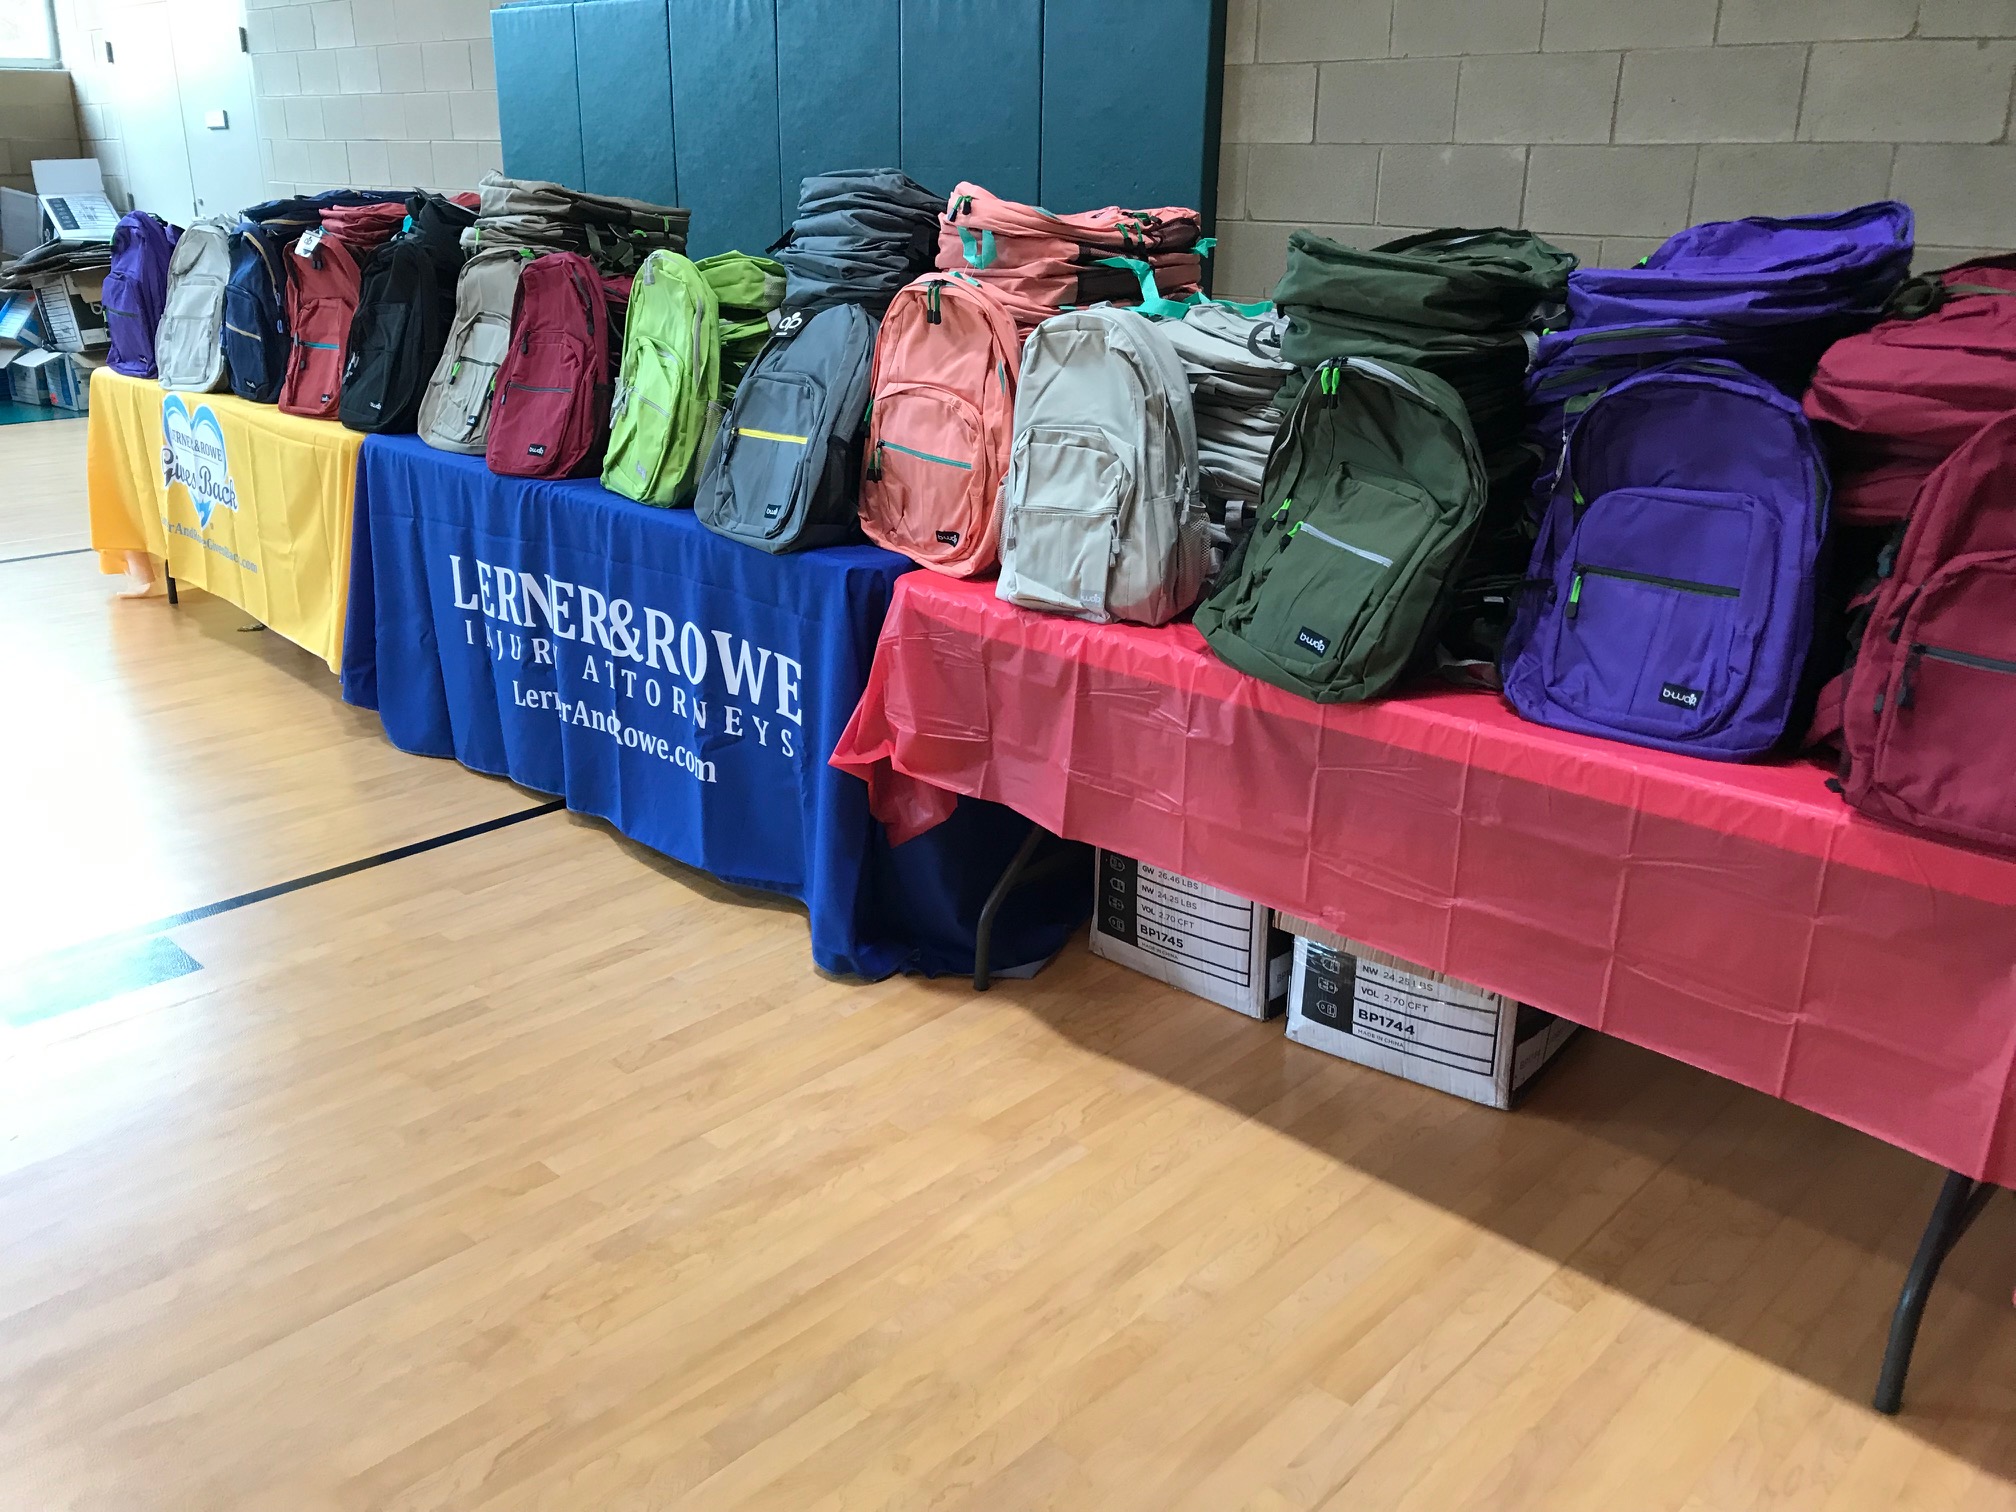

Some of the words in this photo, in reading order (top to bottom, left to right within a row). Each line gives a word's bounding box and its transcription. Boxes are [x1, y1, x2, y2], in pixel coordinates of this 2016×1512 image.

[199, 465, 238, 510] Back
[581, 654, 795, 758] ATTORNEYS
[1141, 865, 1155, 875] GW
[1158, 871, 1180, 884] 26.46
[1181, 879, 1199, 890] LBS
[1141, 884, 1155, 895] NW
[1157, 891, 1179, 904] 24.25
[1180, 899, 1198, 910] LBS
[1140, 903, 1156, 916] VOL
[1158, 911, 1176, 923] 2.70
[1177, 918, 1195, 929] CFT
[1140, 924, 1184, 949] BP1745
[1362, 964, 1379, 976] NW
[1383, 971, 1410, 986] 24.25
[1361, 986, 1379, 999] VOL
[1383, 993, 1405, 1007] 2.70
[1407, 1001, 1429, 1013] CFT
[1358, 1008, 1415, 1036] BP1744
[1357, 1028, 1376, 1039] MADE
[1384, 1037, 1404, 1048] CHINA
